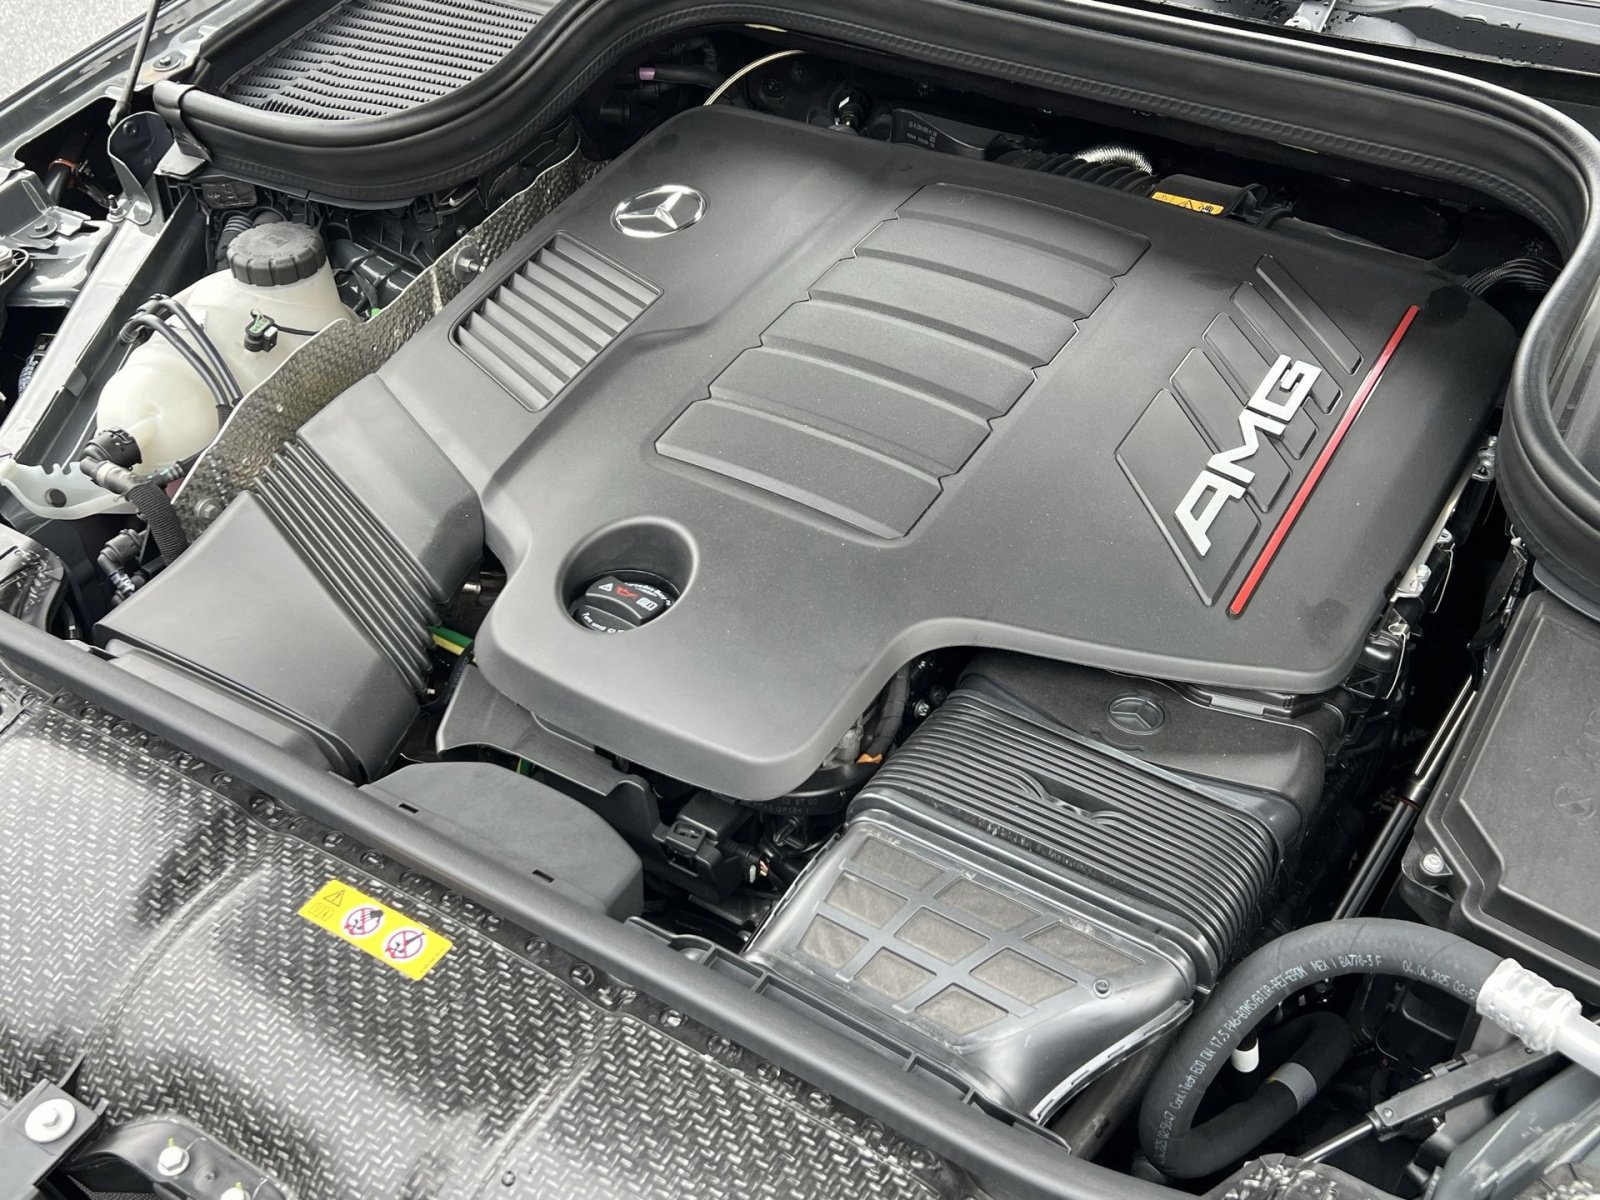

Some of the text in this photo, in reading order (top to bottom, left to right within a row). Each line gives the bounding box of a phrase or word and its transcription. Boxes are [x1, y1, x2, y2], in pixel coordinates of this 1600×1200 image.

[1174, 354, 1323, 557] AMG
[1169, 1074, 1198, 1109] ContiTech
[1209, 1029, 1231, 1048] 17,5
[1310, 959, 1330, 973] MEX
